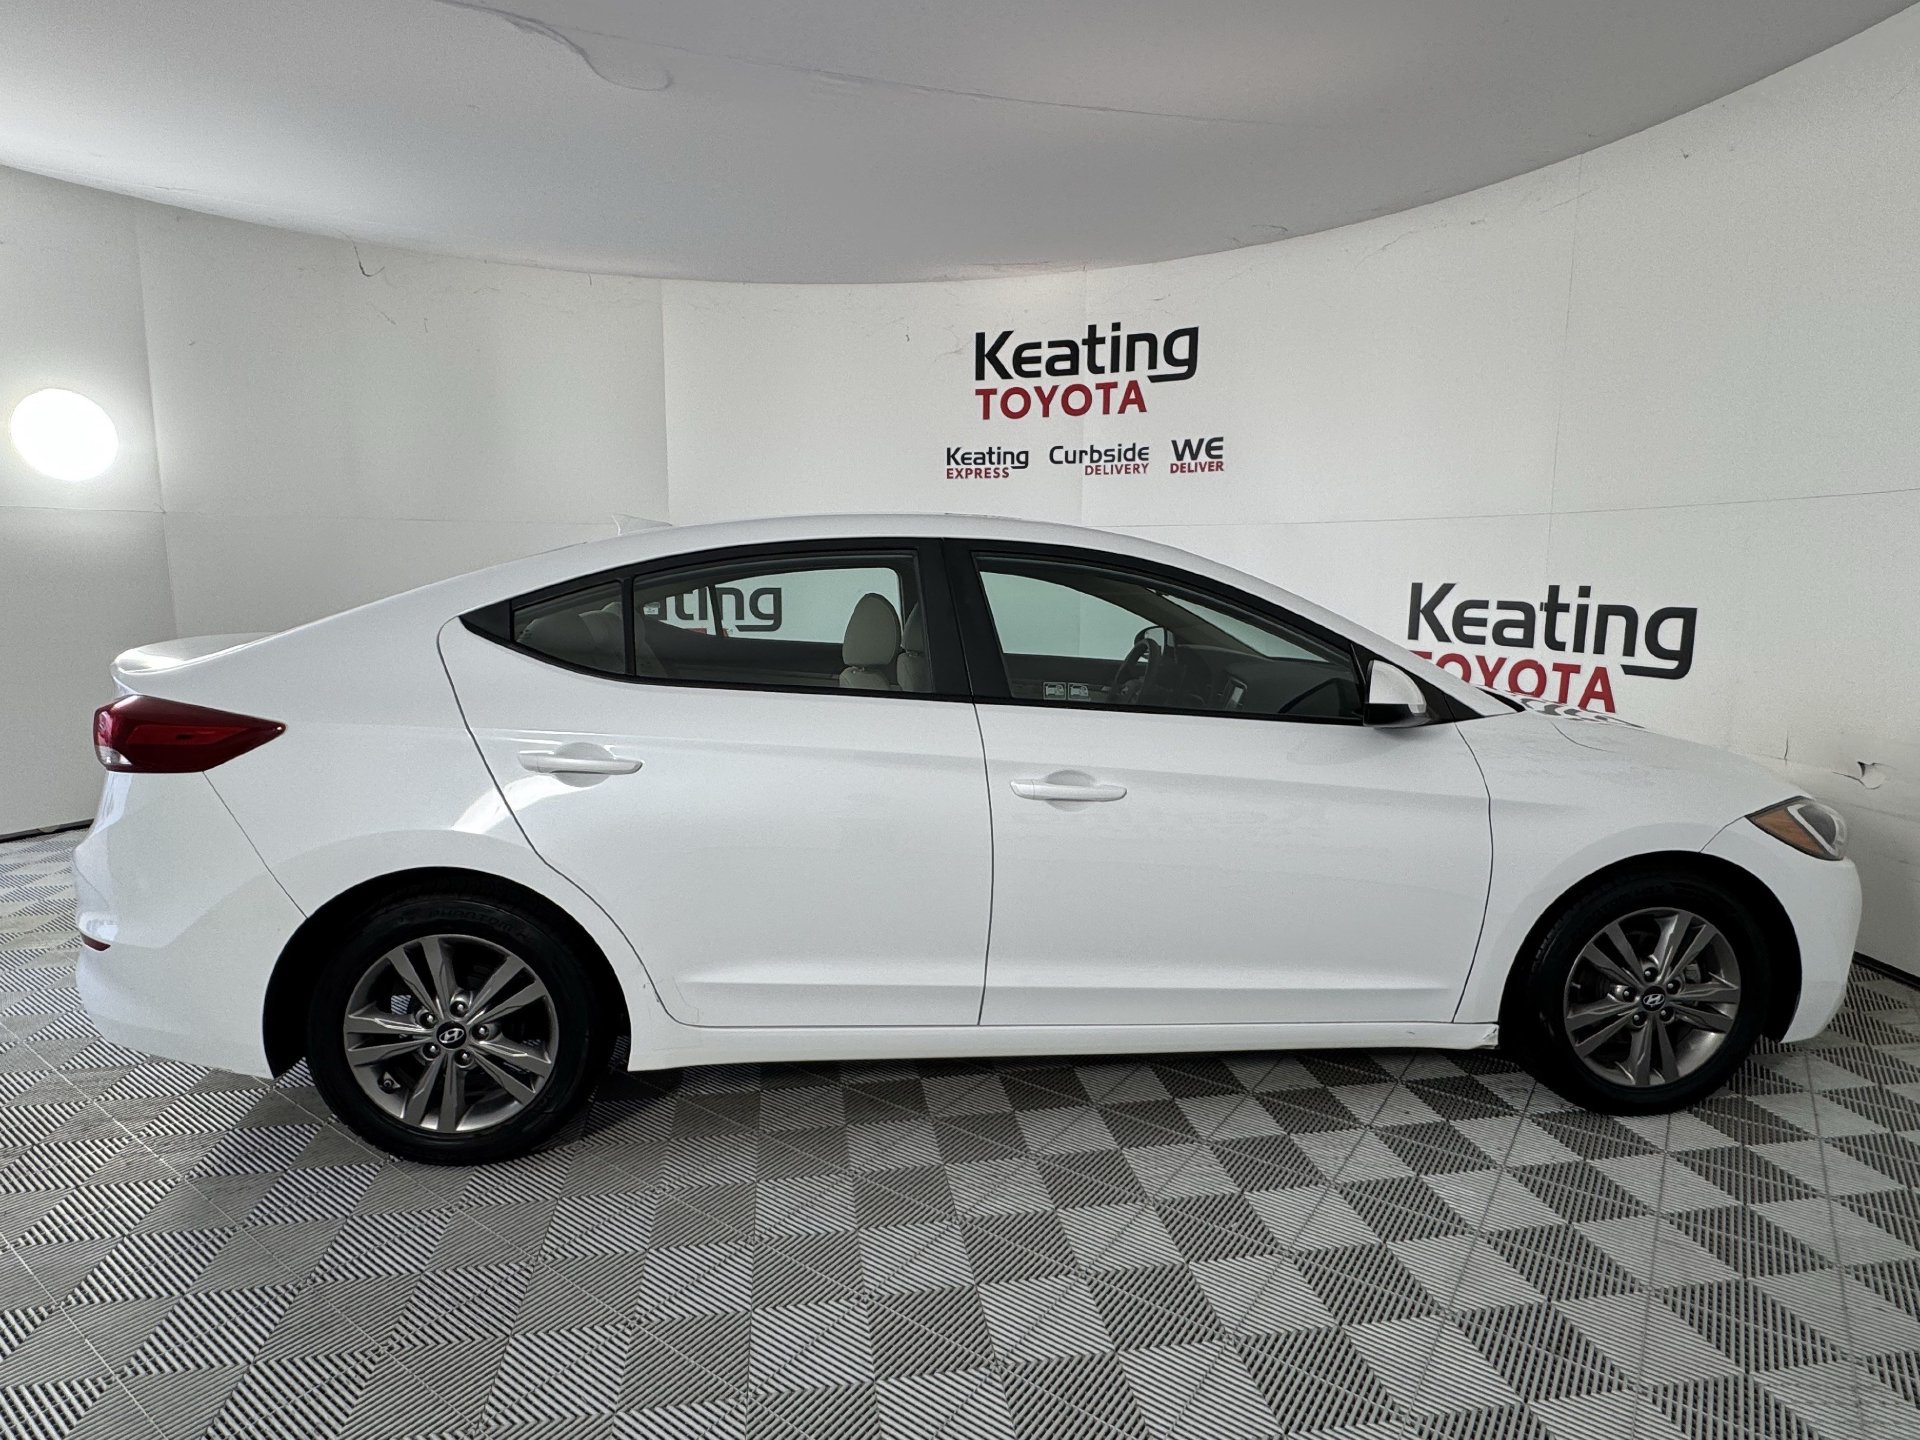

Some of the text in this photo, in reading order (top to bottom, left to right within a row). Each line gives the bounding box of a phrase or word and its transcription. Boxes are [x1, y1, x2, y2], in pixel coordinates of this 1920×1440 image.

[975, 321, 1199, 383] Keating
[975, 380, 1148, 420] TOYOTA
[946, 446, 1029, 469] Keating
[1049, 442, 1149, 465] Curbside
[1171, 436, 1224, 461] WE
[946, 467, 1010, 479] EXPRESS
[1084, 462, 1149, 476] DELIVERY
[1170, 460, 1224, 474] DELIVER
[1407, 582, 1698, 680] Keating
